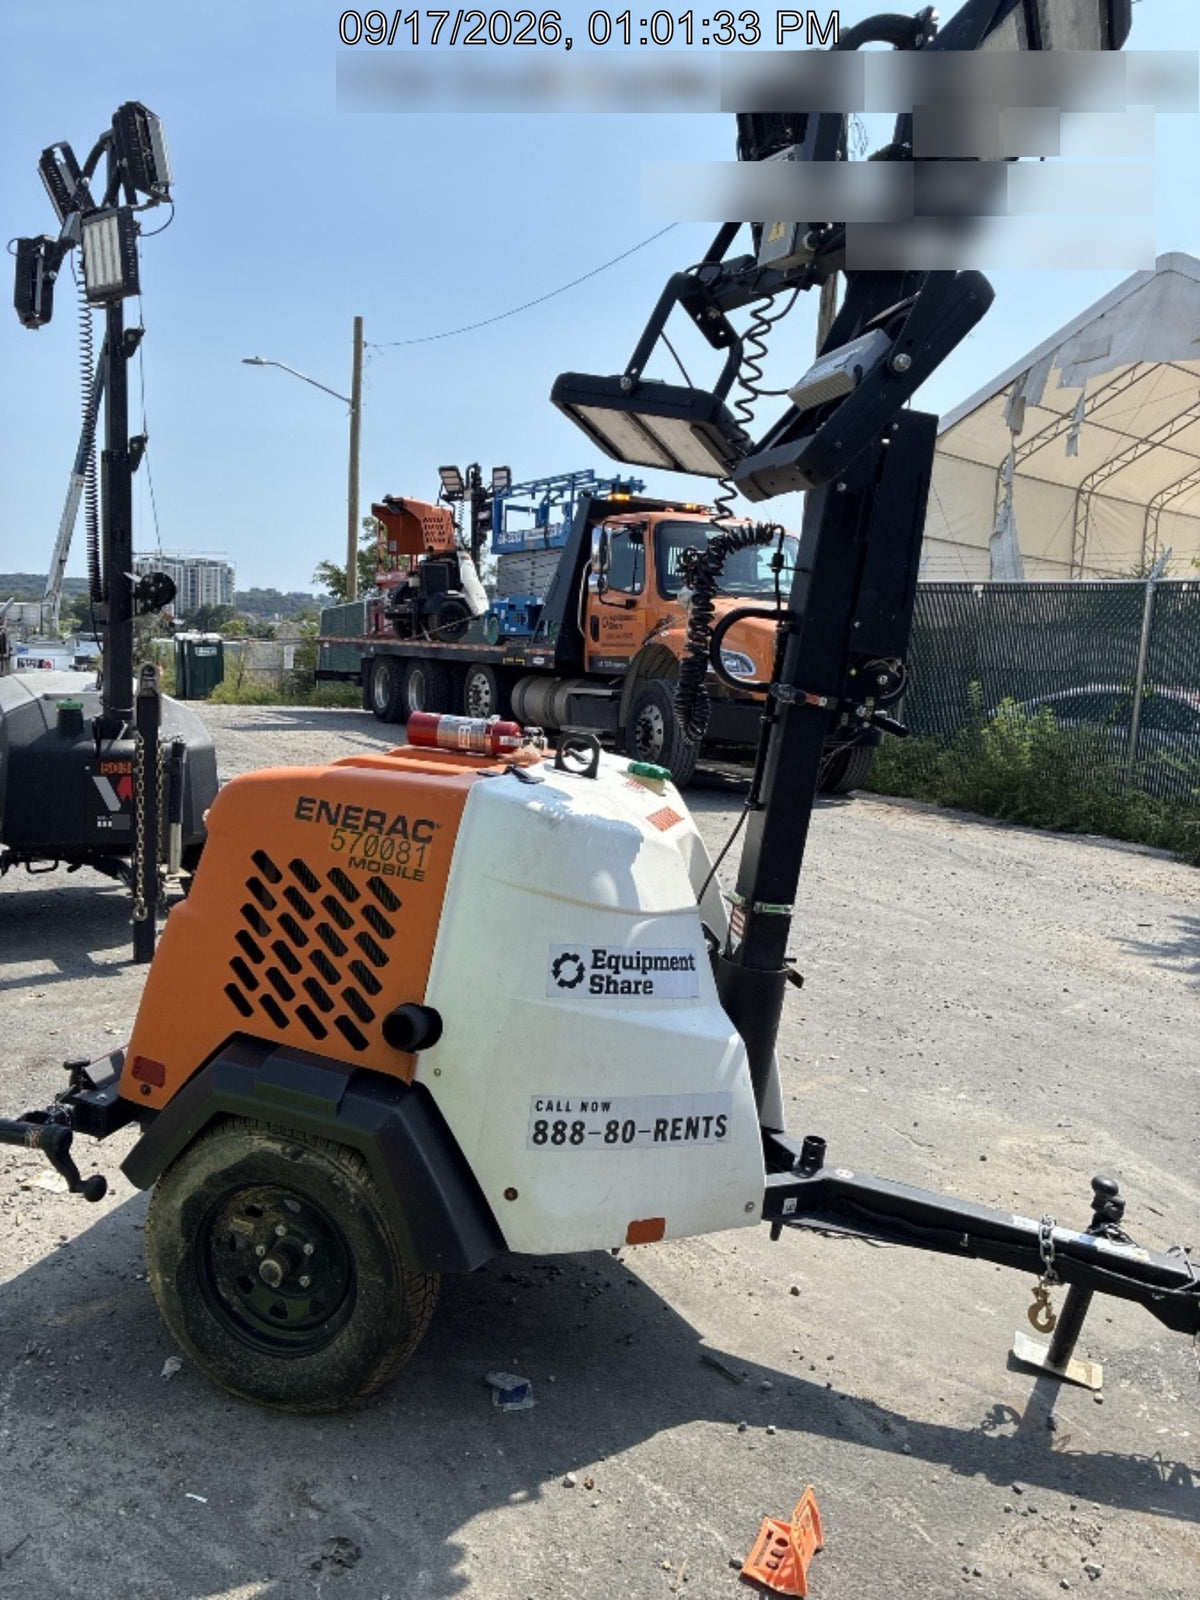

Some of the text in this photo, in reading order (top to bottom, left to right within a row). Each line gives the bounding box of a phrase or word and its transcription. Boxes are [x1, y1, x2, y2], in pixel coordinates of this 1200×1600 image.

[330, 827, 426, 868] 570081
[347, 856, 426, 882] MOBILE
[591, 949, 696, 975] Equipment
[588, 974, 654, 995] Share
[535, 1100, 612, 1112] CALL NOW
[532, 1114, 728, 1146] 888-80-RENTS
